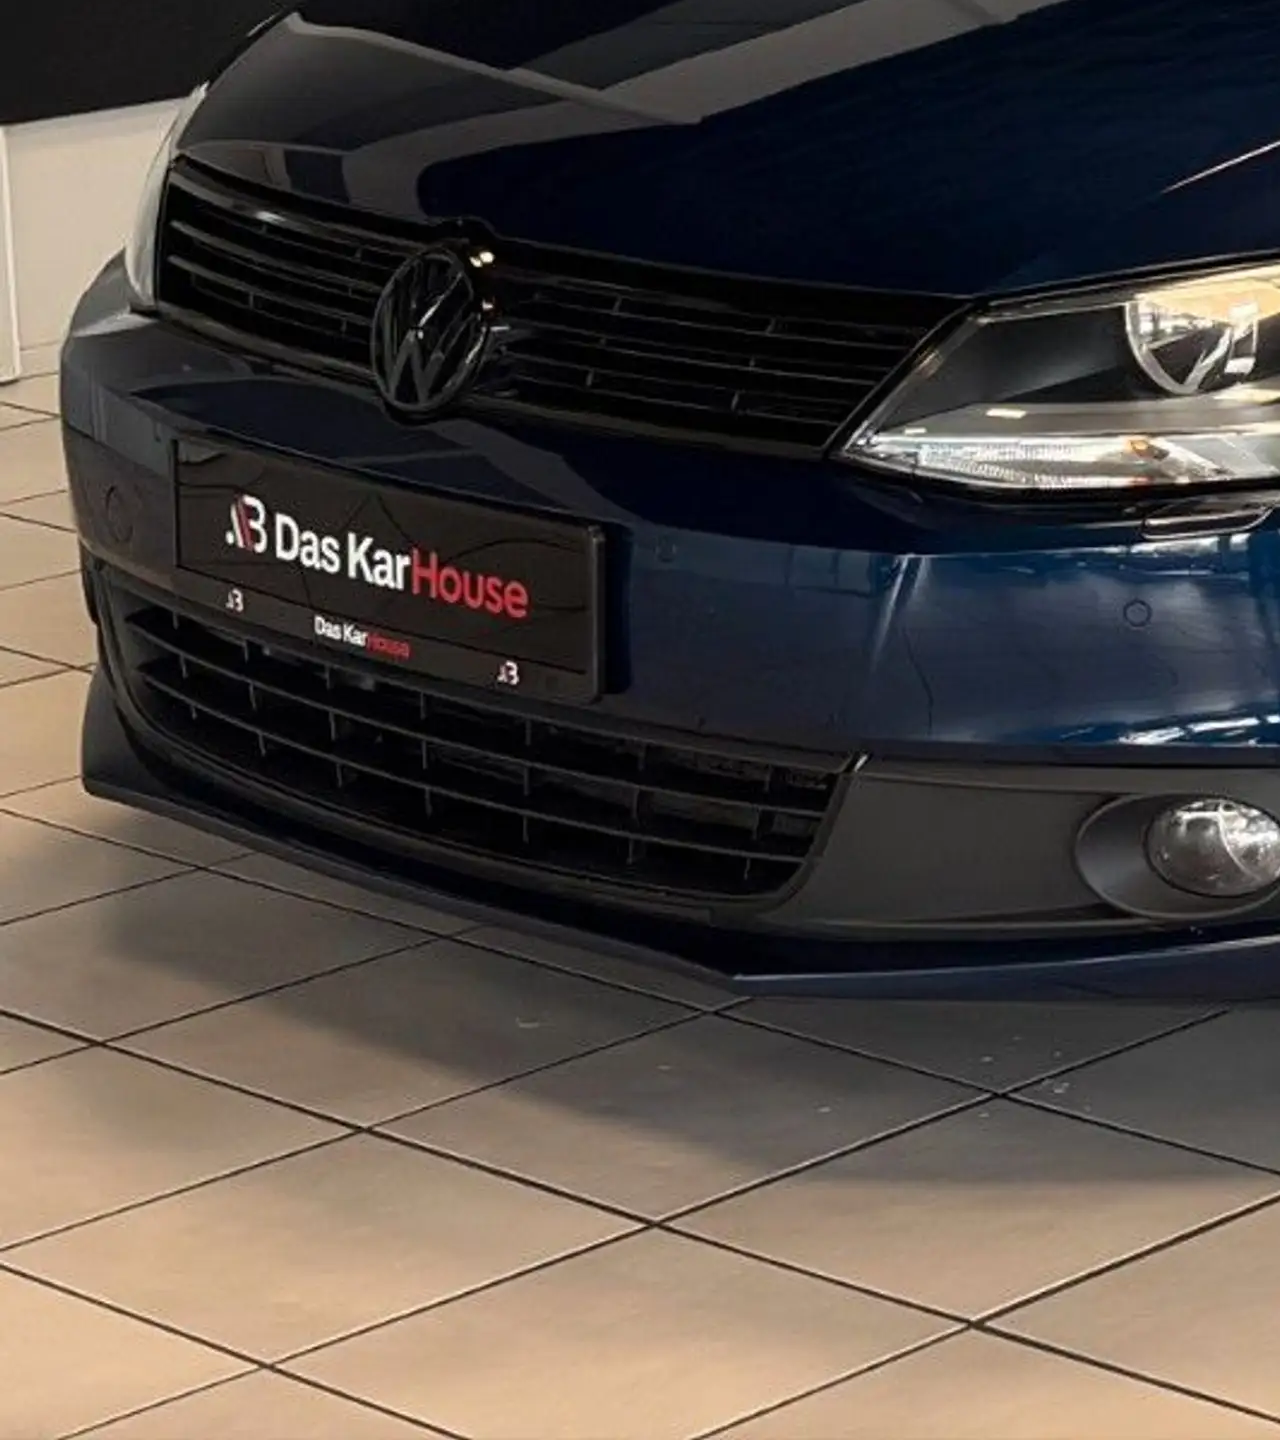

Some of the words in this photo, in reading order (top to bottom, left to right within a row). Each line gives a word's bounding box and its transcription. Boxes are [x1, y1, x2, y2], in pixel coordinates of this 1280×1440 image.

[275, 512, 341, 574] Das
[347, 531, 529, 619] KarHouse
[314, 614, 342, 640] Das
